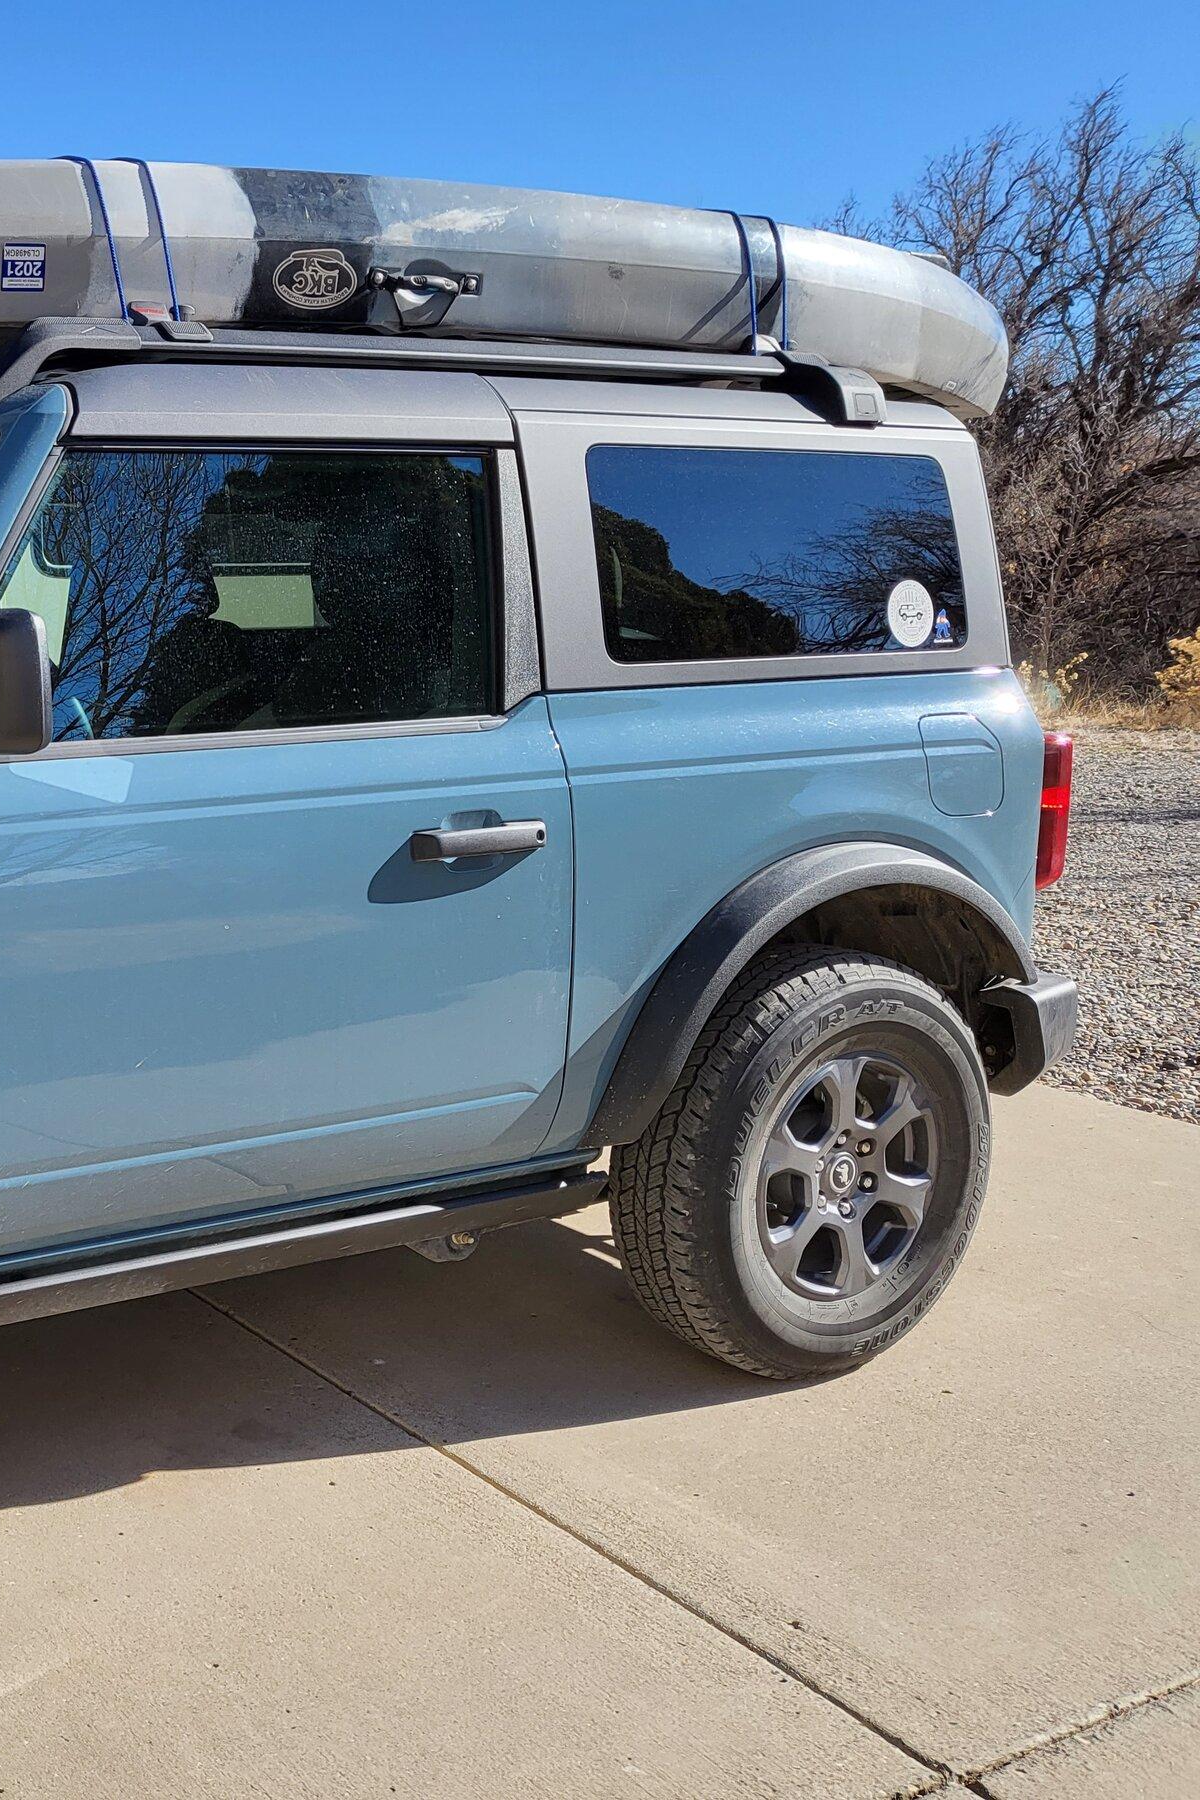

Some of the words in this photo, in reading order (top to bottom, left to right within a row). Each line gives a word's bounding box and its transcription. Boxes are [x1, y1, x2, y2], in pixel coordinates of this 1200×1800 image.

[5, 249, 41, 257] CL9498GK
[7, 261, 42, 276] 2021
[292, 270, 339, 295] BKC
[280, 286, 303, 302] COMPANY
[320, 288, 348, 304] BROOKLYN
[722, 1003, 848, 1201] DUELER
[854, 999, 905, 1018] A/T
